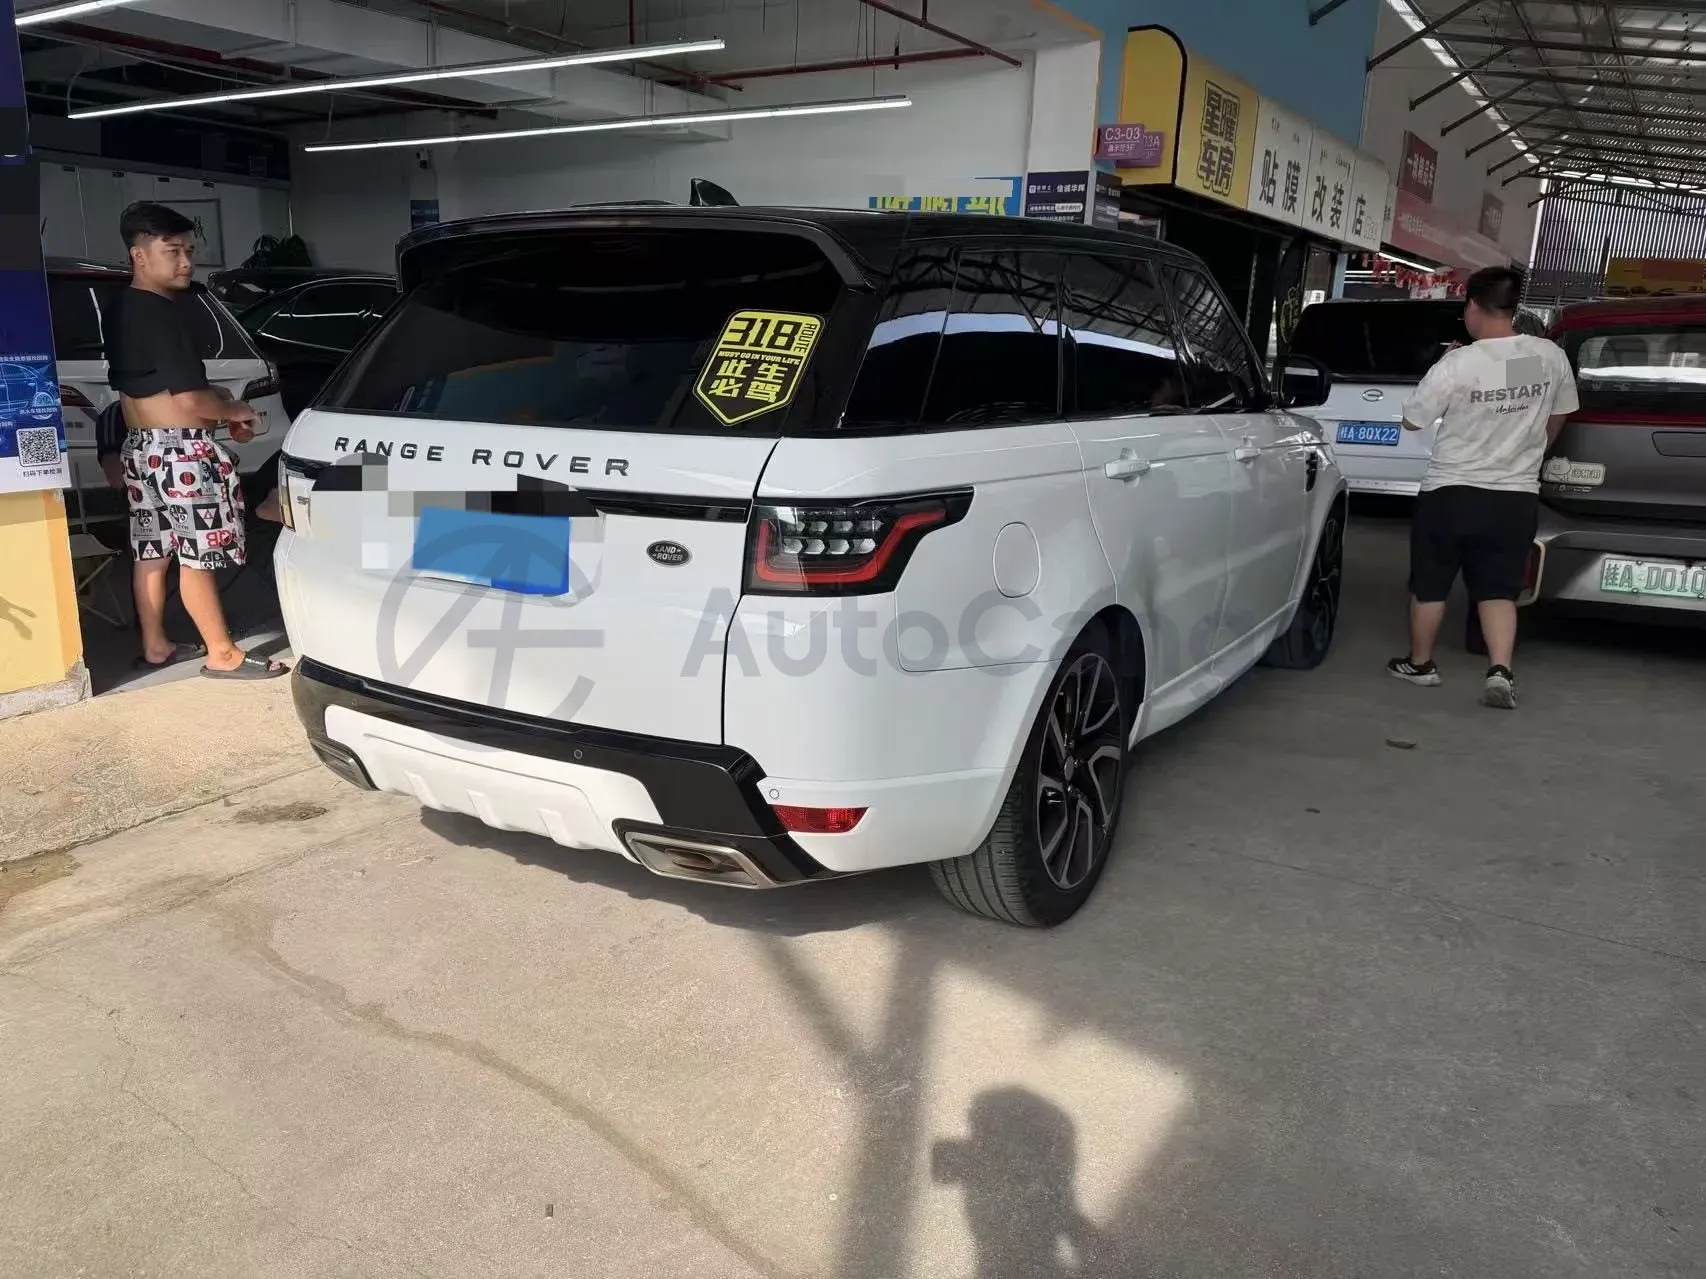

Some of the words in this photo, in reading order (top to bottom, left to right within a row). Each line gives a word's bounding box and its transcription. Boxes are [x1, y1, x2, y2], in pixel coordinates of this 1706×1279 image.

[1105, 126, 1141, 141] C3-03
[721, 317, 803, 351] 318
[793, 322, 818, 355] ROUTE
[718, 350, 740, 359] MUST
[760, 354, 781, 362] YOUR
[782, 357, 801, 365] LIFE
[716, 359, 788, 383] 此生
[708, 378, 781, 403] 必驾
[1470, 382, 1551, 403] RESTART
[334, 436, 445, 461] RANGE
[472, 448, 629, 477] ROVER
[655, 545, 677, 554] LAND
[656, 552, 683, 561] ROVER
